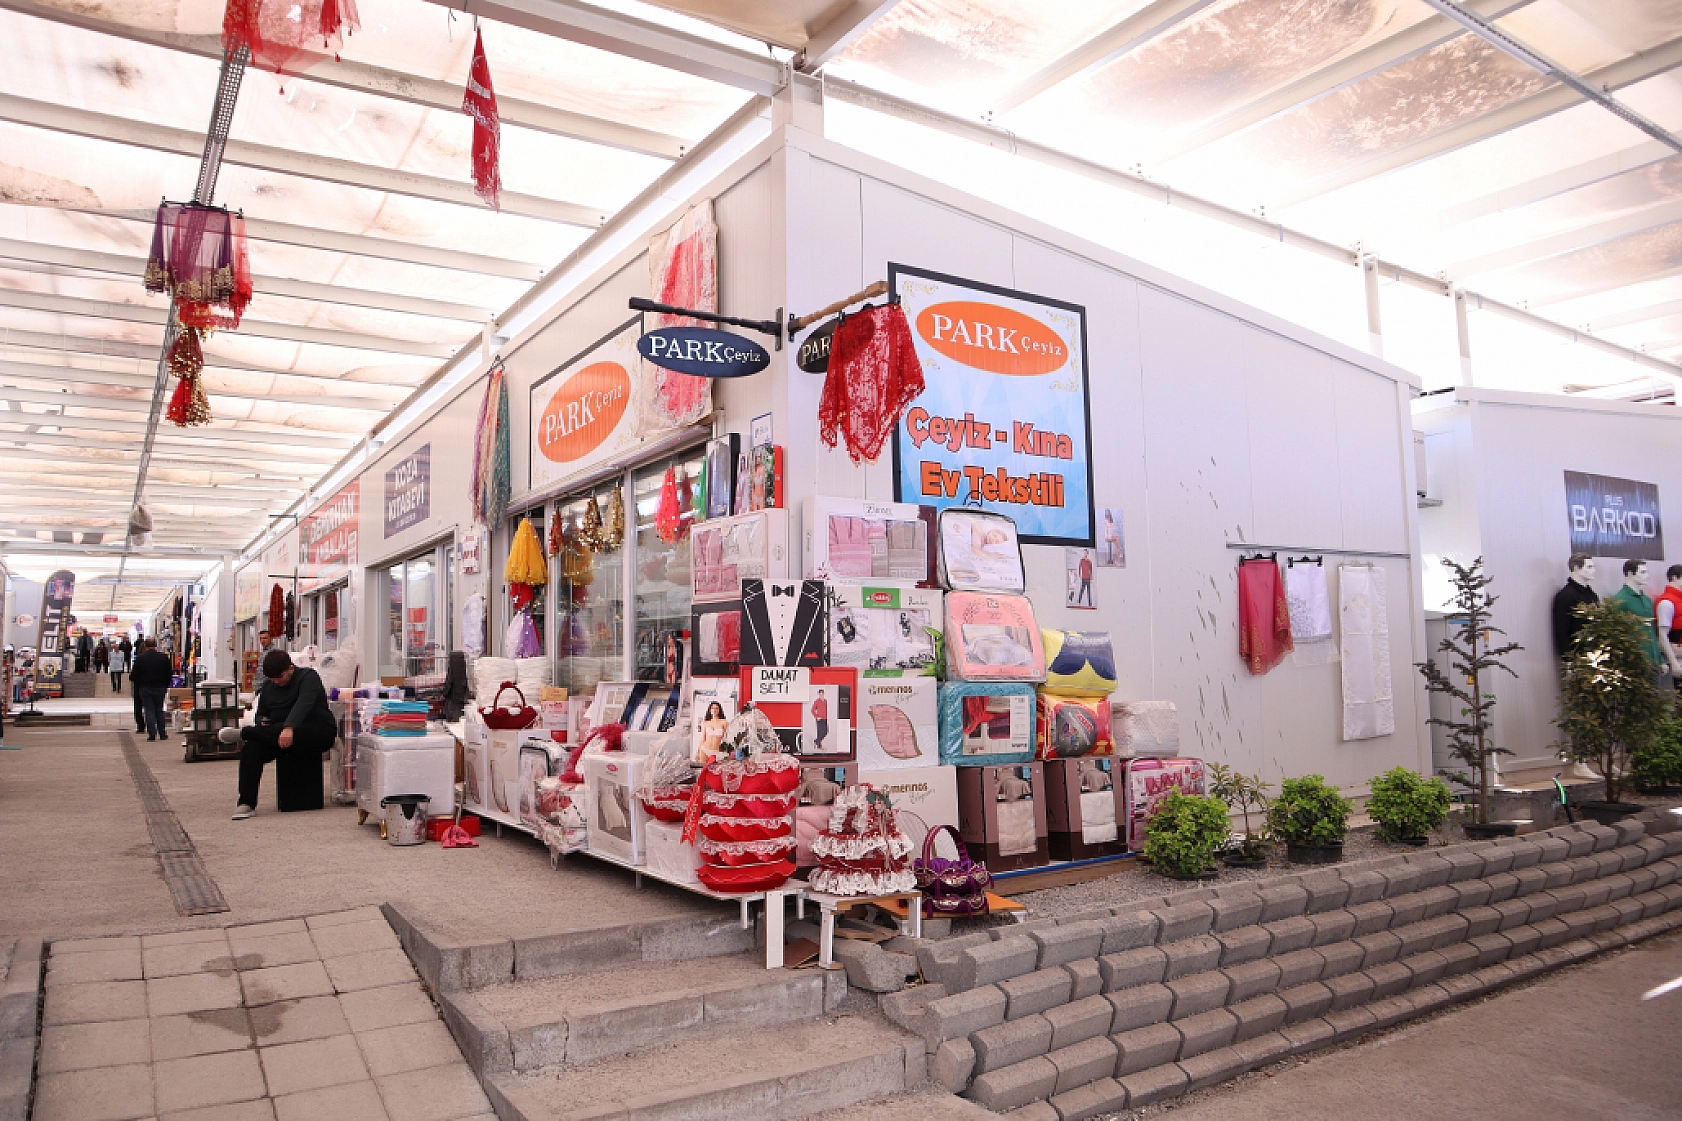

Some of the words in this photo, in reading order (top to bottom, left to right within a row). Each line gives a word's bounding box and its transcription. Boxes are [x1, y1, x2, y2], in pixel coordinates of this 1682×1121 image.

[649, 336, 725, 363] PARK
[724, 347, 761, 364] Çeyiz
[801, 333, 833, 367] PAR
[931, 314, 1020, 355] PARK
[1021, 335, 1061, 356] Çeyiz
[545, 390, 595, 446] PARK
[595, 384, 622, 413] Çeyiz
[906, 406, 992, 453] Çeyiz
[995, 430, 1007, 444] -
[1013, 420, 1073, 461] Kına
[920, 460, 961, 498] Ev
[963, 465, 1065, 508] Tekstili
[1571, 504, 1657, 538] BARKOD
[760, 681, 789, 695] SETİ
[761, 669, 799, 682] DAMAT
